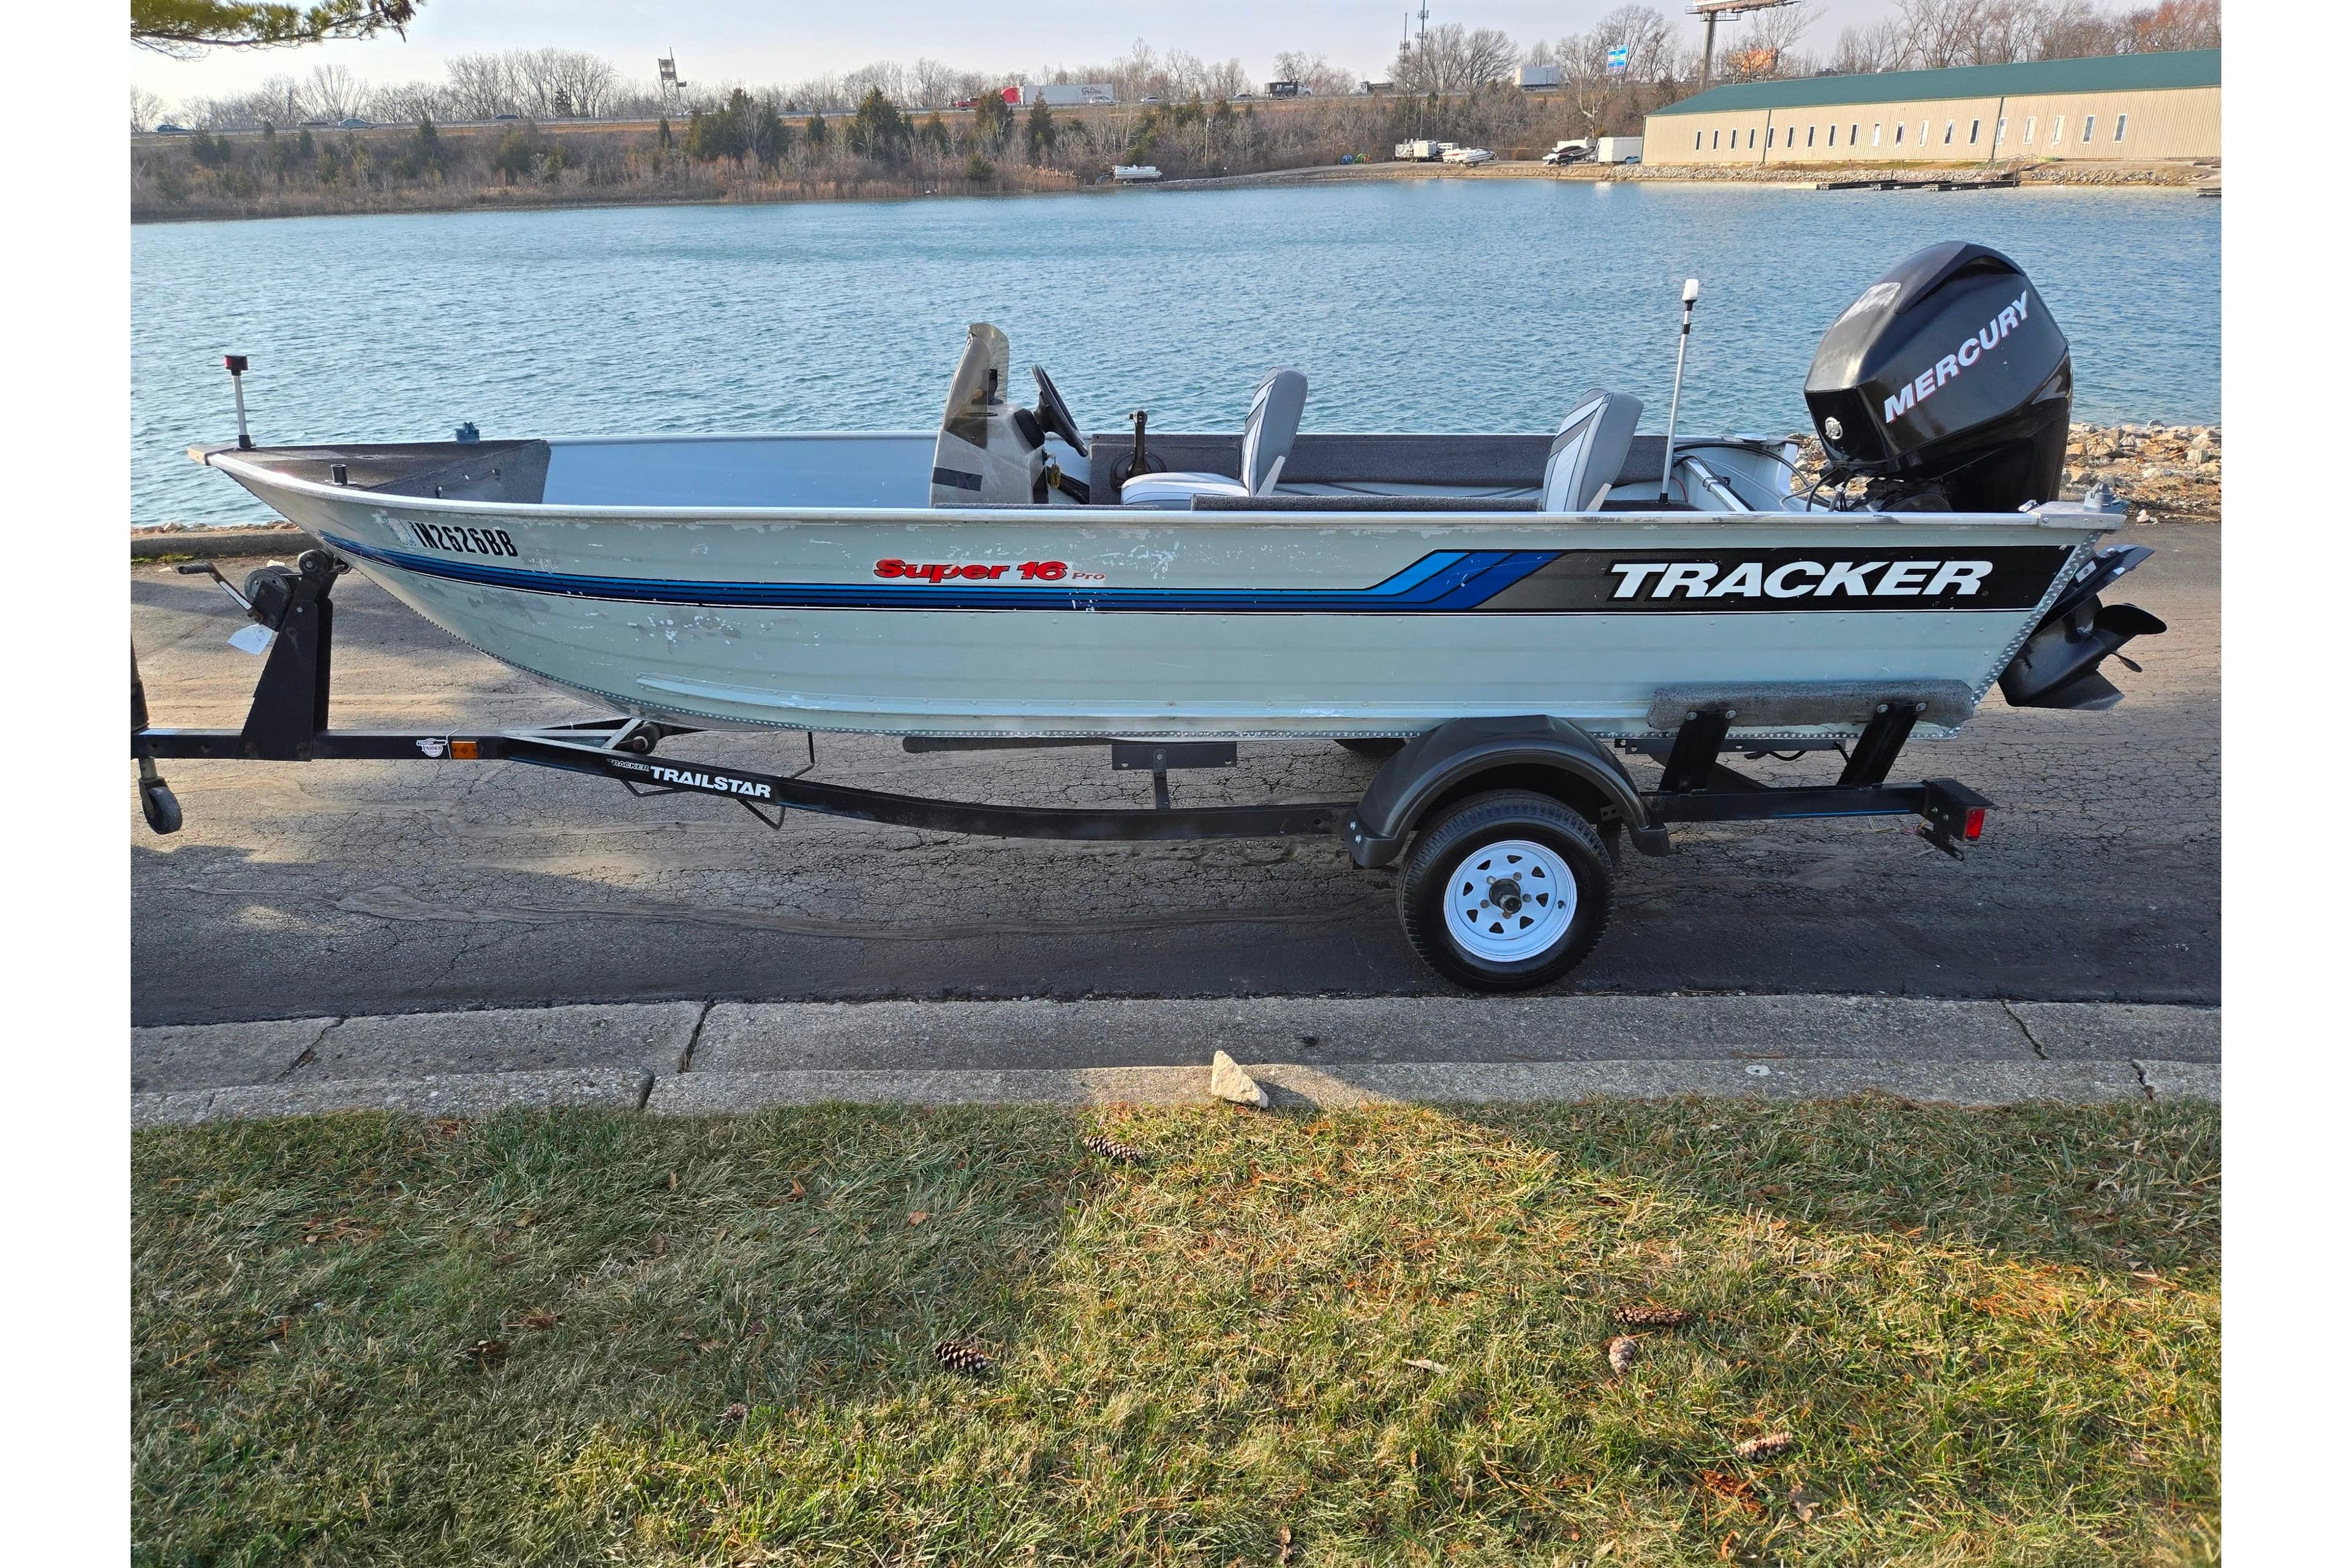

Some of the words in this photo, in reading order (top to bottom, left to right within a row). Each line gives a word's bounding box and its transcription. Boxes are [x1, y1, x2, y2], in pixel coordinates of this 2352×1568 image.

[1884, 290, 2029, 424] MERCURY
[408, 521, 519, 557] IN2626BB
[874, 559, 1009, 583] Super
[1017, 561, 1069, 581] 16
[1071, 571, 1106, 581] Pro
[1610, 560, 1994, 598] TRACKER
[607, 758, 650, 772] TRACKER
[650, 766, 772, 799] TRAILSTAR
